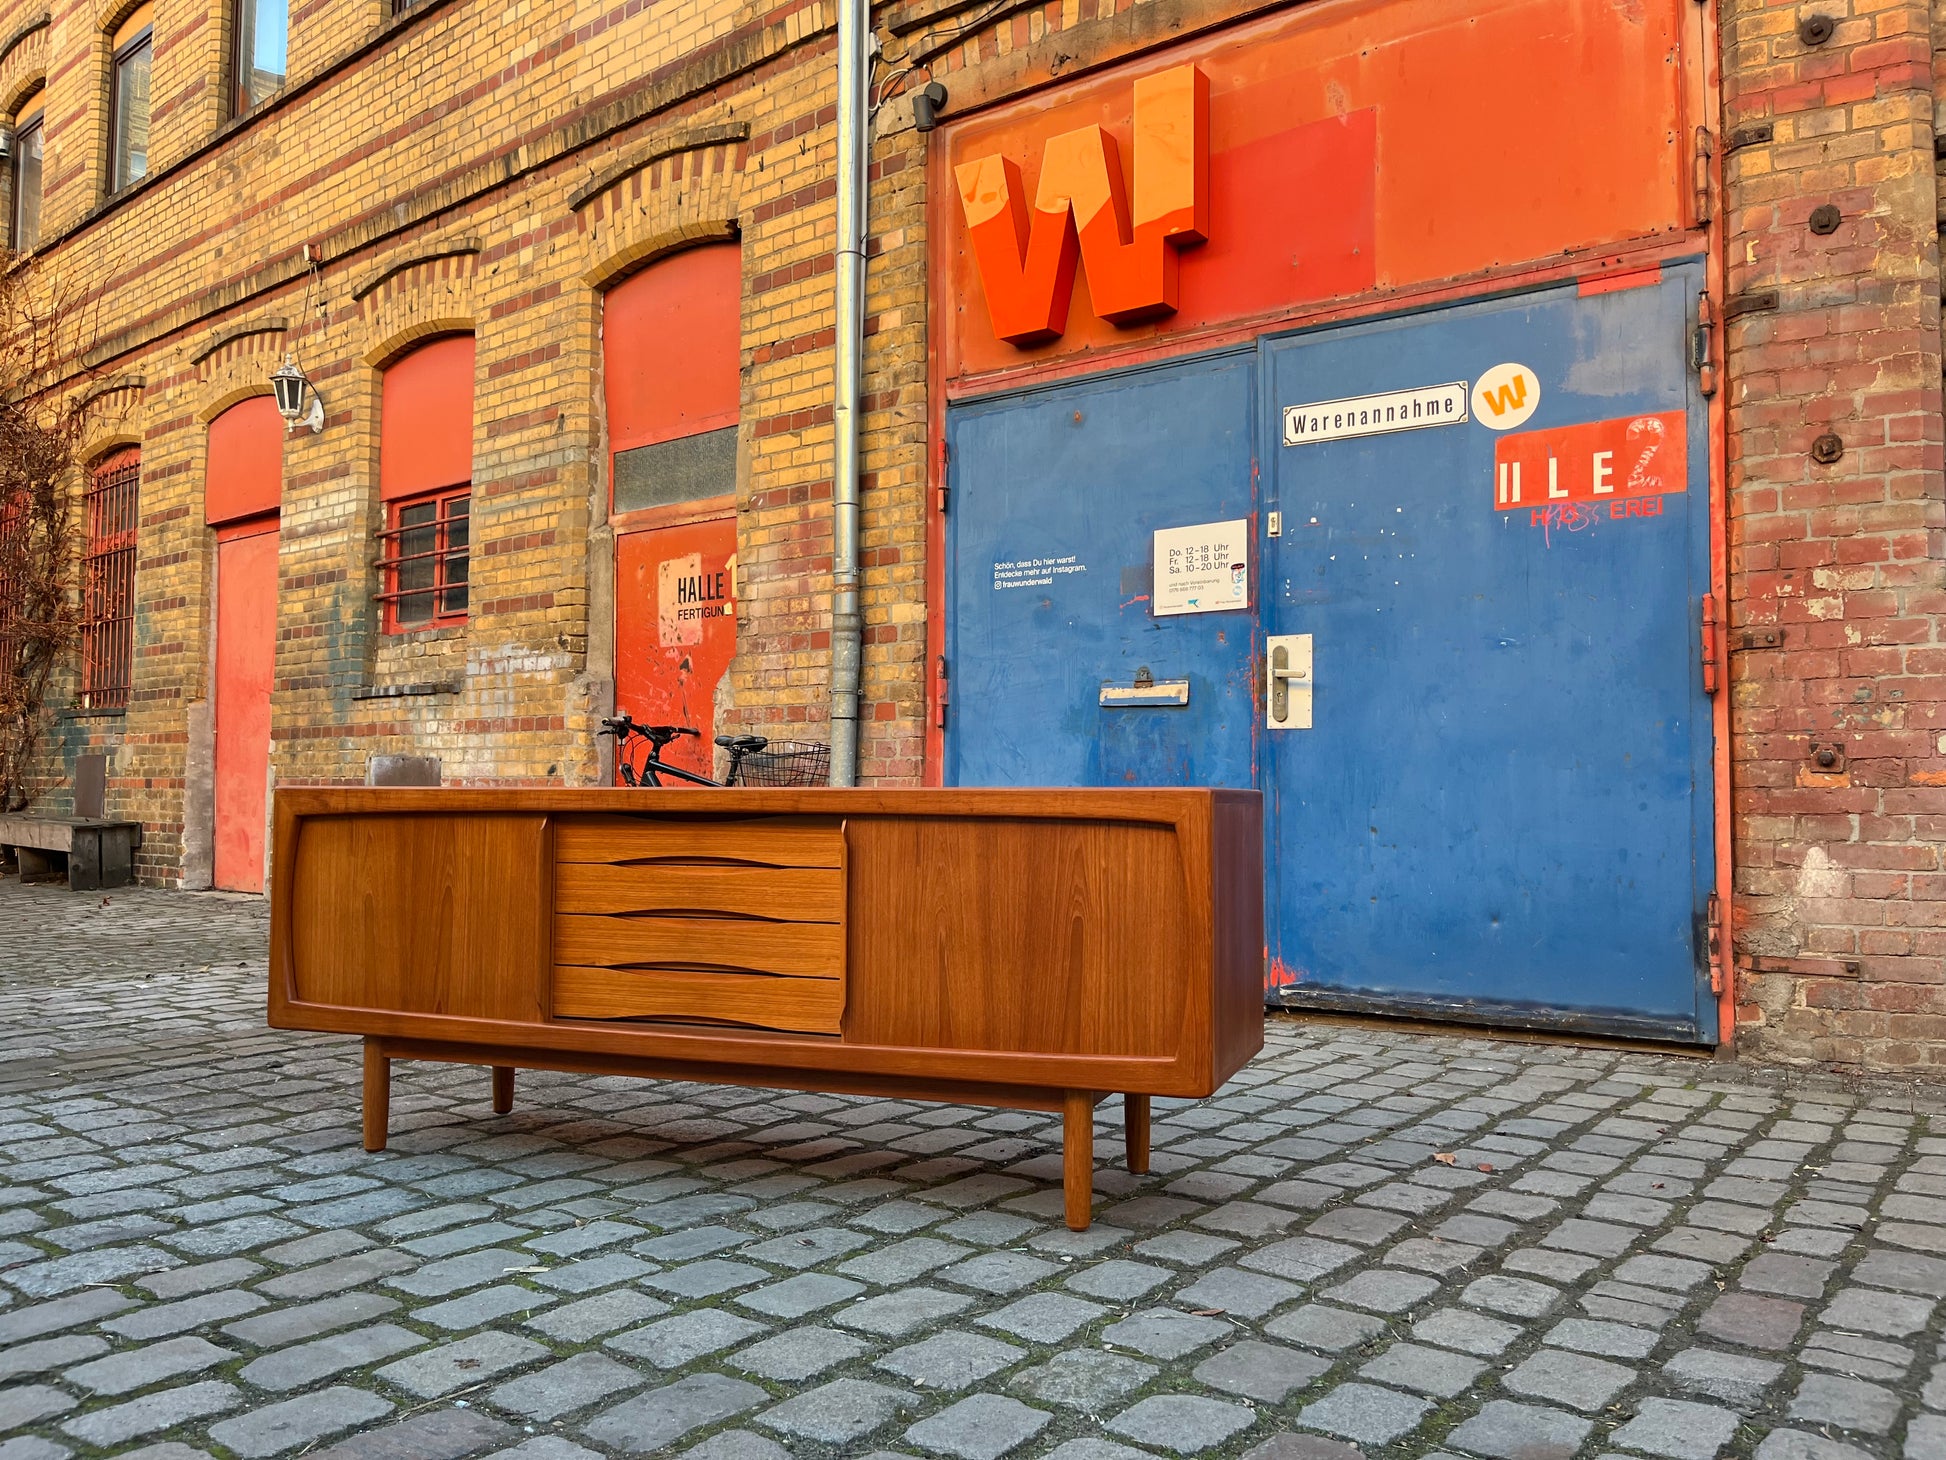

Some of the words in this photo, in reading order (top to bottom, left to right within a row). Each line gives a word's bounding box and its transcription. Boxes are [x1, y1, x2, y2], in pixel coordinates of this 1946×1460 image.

[954, 62, 1210, 350] W
[1482, 374, 1527, 417] W
[1292, 397, 1454, 434] Warenannahme
[1169, 549, 1183, 557] Do.
[1214, 544, 1230, 552] Uhr
[994, 562, 1016, 571] Schön,
[1017, 560, 1032, 568] dass
[1033, 558, 1042, 567] Du
[1043, 557, 1056, 566] hier
[1057, 555, 1076, 564] warst!
[1169, 557, 1179, 566] Fr.
[1214, 553, 1230, 561] Uhr
[1169, 566, 1182, 574] Sa.
[1214, 561, 1230, 570] Uhr
[678, 572, 725, 604] HALLE
[724, 552, 738, 598] 1
[994, 569, 1022, 579] Entdecke
[1023, 567, 1040, 577] mehr
[1041, 566, 1052, 575] auf
[1053, 564, 1087, 574] Instagram.
[678, 605, 730, 621] FERTIGUN
